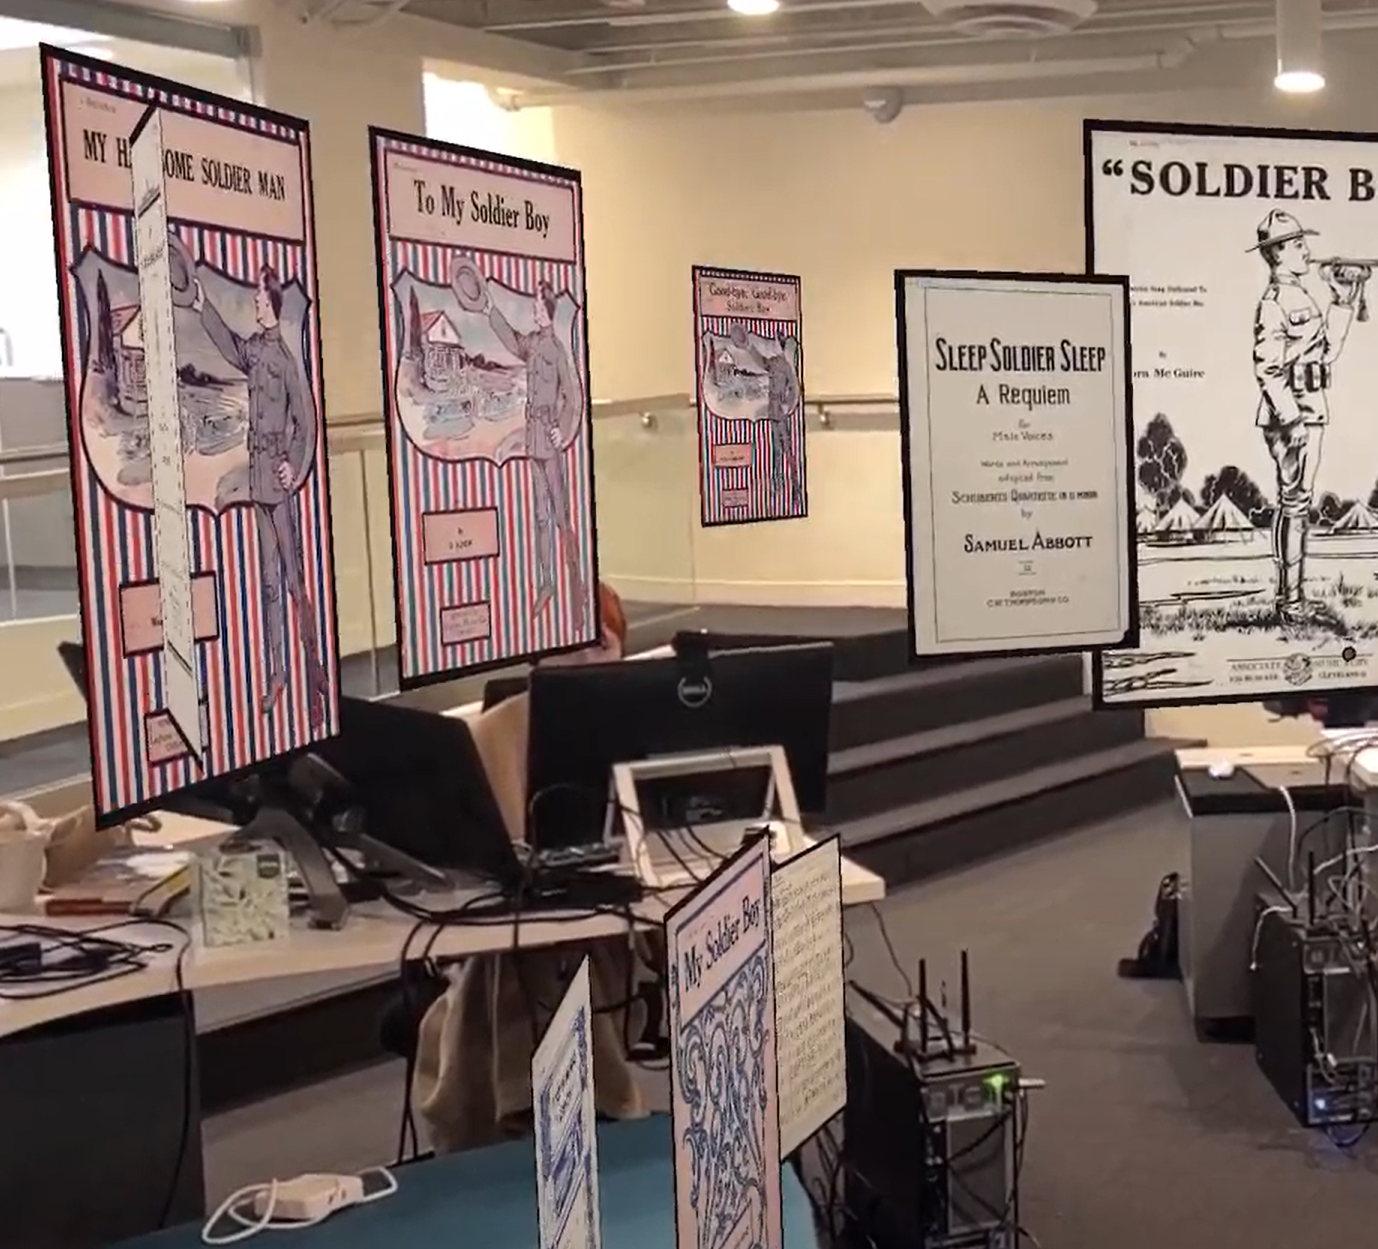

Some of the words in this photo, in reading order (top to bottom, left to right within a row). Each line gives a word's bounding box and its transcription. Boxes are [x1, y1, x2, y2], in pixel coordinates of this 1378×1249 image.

[83, 129, 107, 163] MY
[201, 157, 253, 195] SOLDIER
[258, 170, 285, 201] MAN
[414, 179, 435, 215] To
[441, 184, 465, 226] My
[470, 190, 520, 228] Soldier
[524, 200, 550, 238] Boy
[935, 337, 987, 372] SLEEP
[989, 337, 1055, 372] SOLDIER
[1060, 339, 1106, 372] SLEEP
[976, 384, 990, 405] A
[999, 384, 1070, 411] Requiem
[963, 532, 1029, 554] SAMUEL
[1031, 528, 1093, 550] ABBOTT
[684, 945, 703, 993] My
[706, 914, 741, 971] Soldier
[742, 895, 760, 934] Boy
